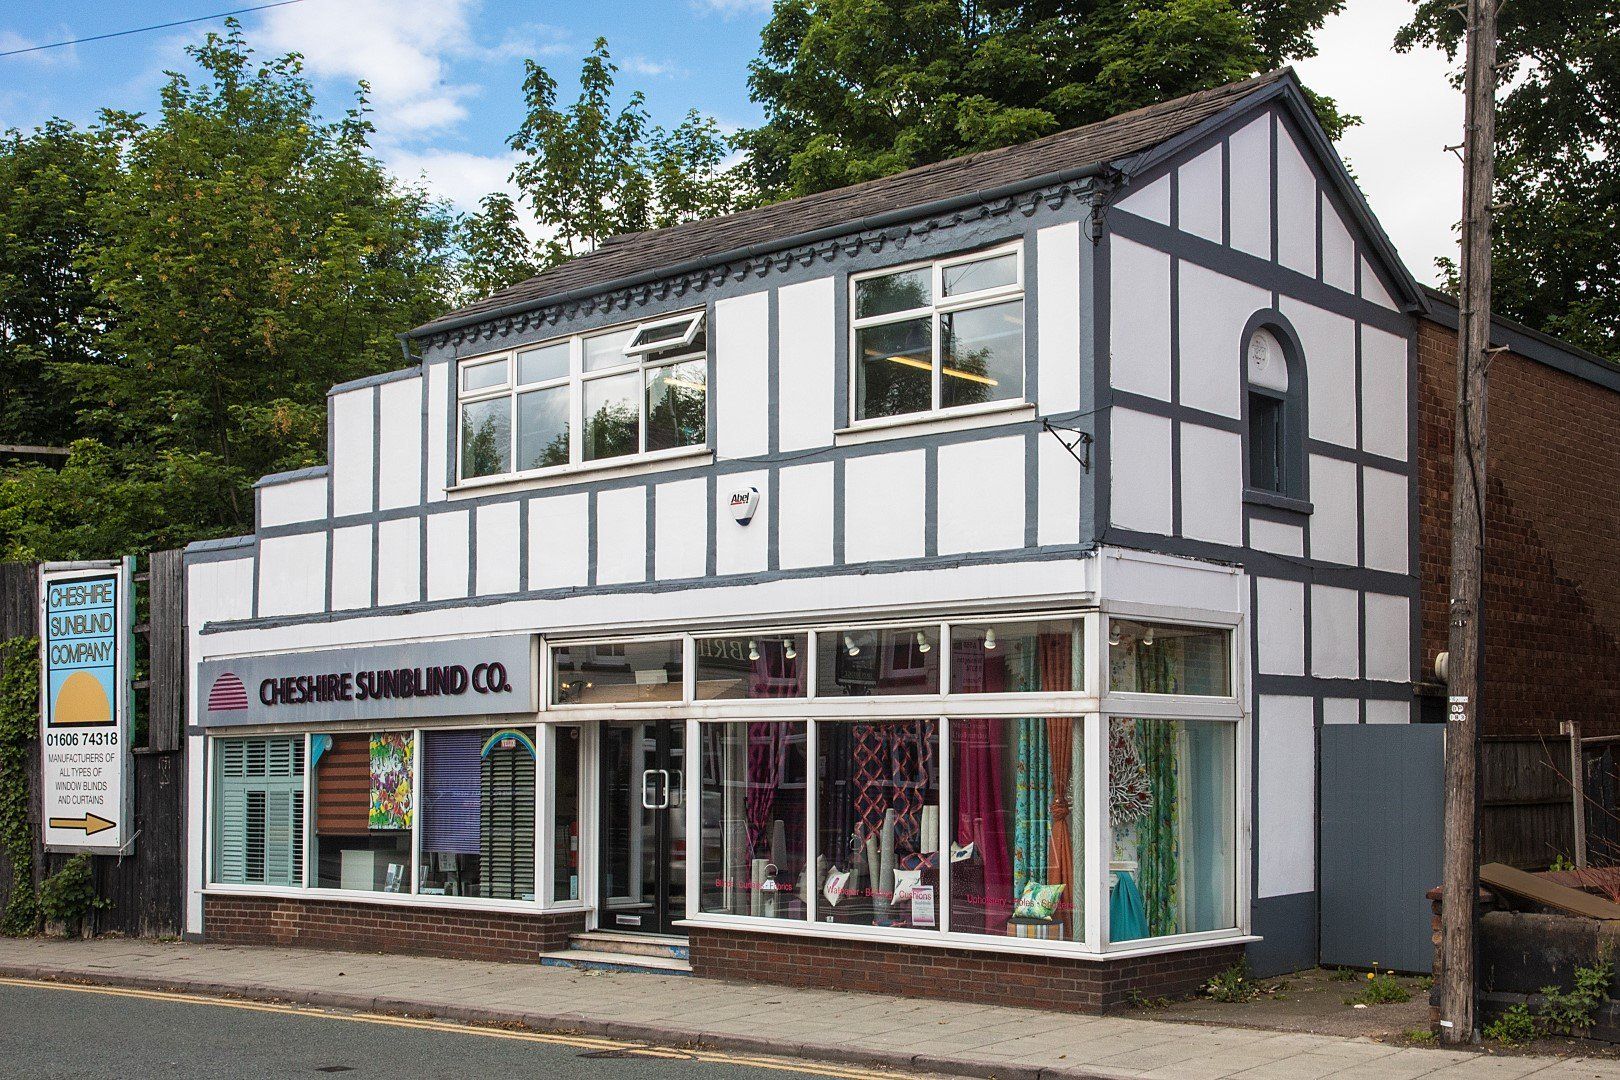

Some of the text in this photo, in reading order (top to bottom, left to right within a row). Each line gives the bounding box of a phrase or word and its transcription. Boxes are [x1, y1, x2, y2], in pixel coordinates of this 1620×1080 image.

[731, 493, 750, 504] Abel
[50, 583, 113, 608] CHESHIRE
[50, 612, 113, 637] SUNBLIND
[51, 641, 113, 665] COMPANY
[259, 661, 512, 706] CHESHIRE SUNBLIND CO.
[46, 732, 118, 746] 01606 74318
[48, 752, 115, 763] MANUFACTURERS OF
[60, 767, 102, 777] ALL TYPES OF
[55, 781, 108, 791] WINDOW BLINDS
[58, 795, 104, 805] AND CURTAINS
[899, 890, 932, 901] Cushions
